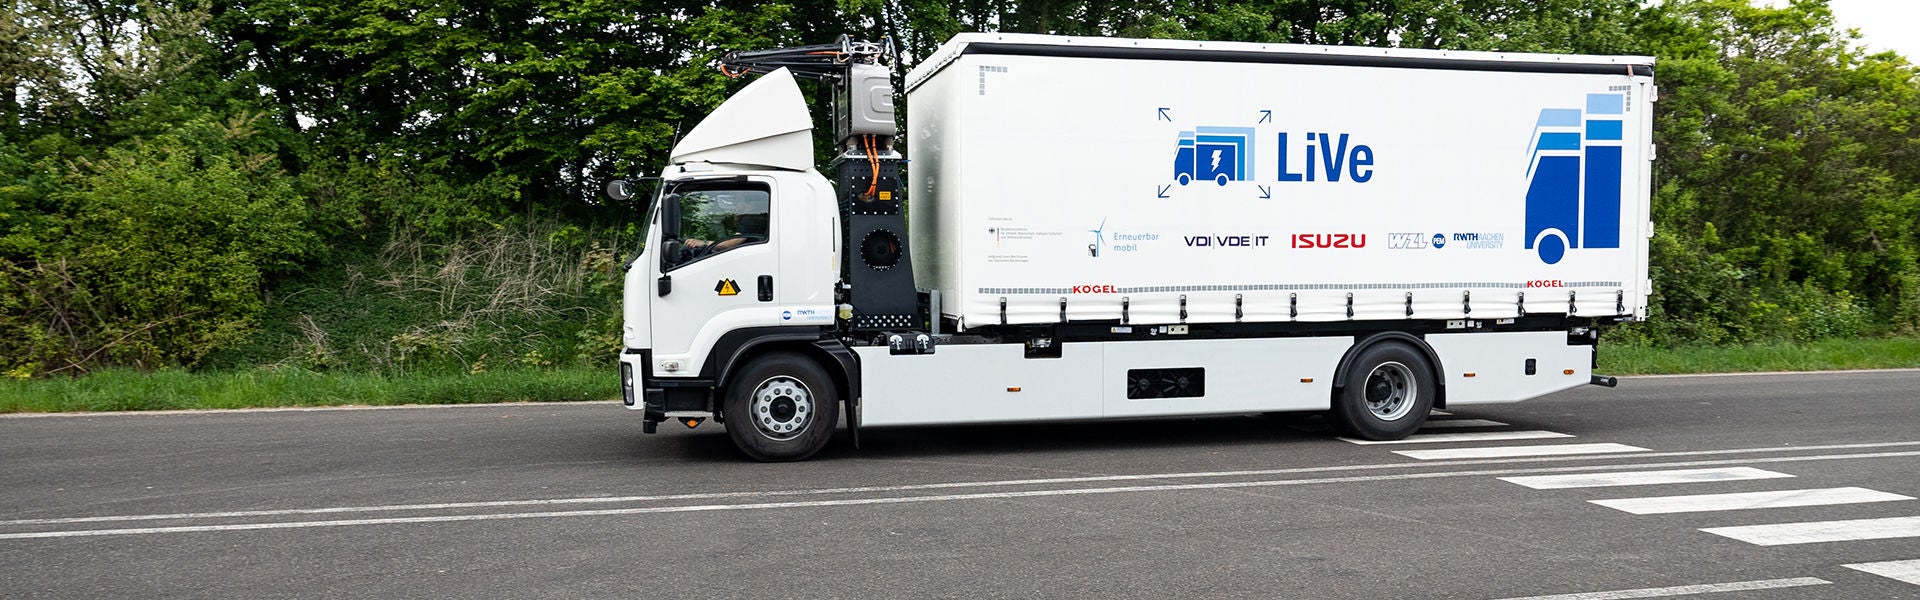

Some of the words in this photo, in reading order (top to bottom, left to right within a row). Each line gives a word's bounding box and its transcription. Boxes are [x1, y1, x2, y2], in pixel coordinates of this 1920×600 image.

[1278, 132, 1374, 183] LiVe
[1113, 232, 1159, 241] Erneuerbar
[1184, 236, 1211, 247] VDI
[1217, 236, 1250, 247] VDE
[1255, 236, 1269, 247] IT
[1291, 233, 1366, 249] ISUZU
[1388, 233, 1428, 249] WZL
[1453, 233, 1478, 241] RWTH
[1479, 233, 1504, 241] AACHEN
[1466, 241, 1503, 249] UNIVERSITY
